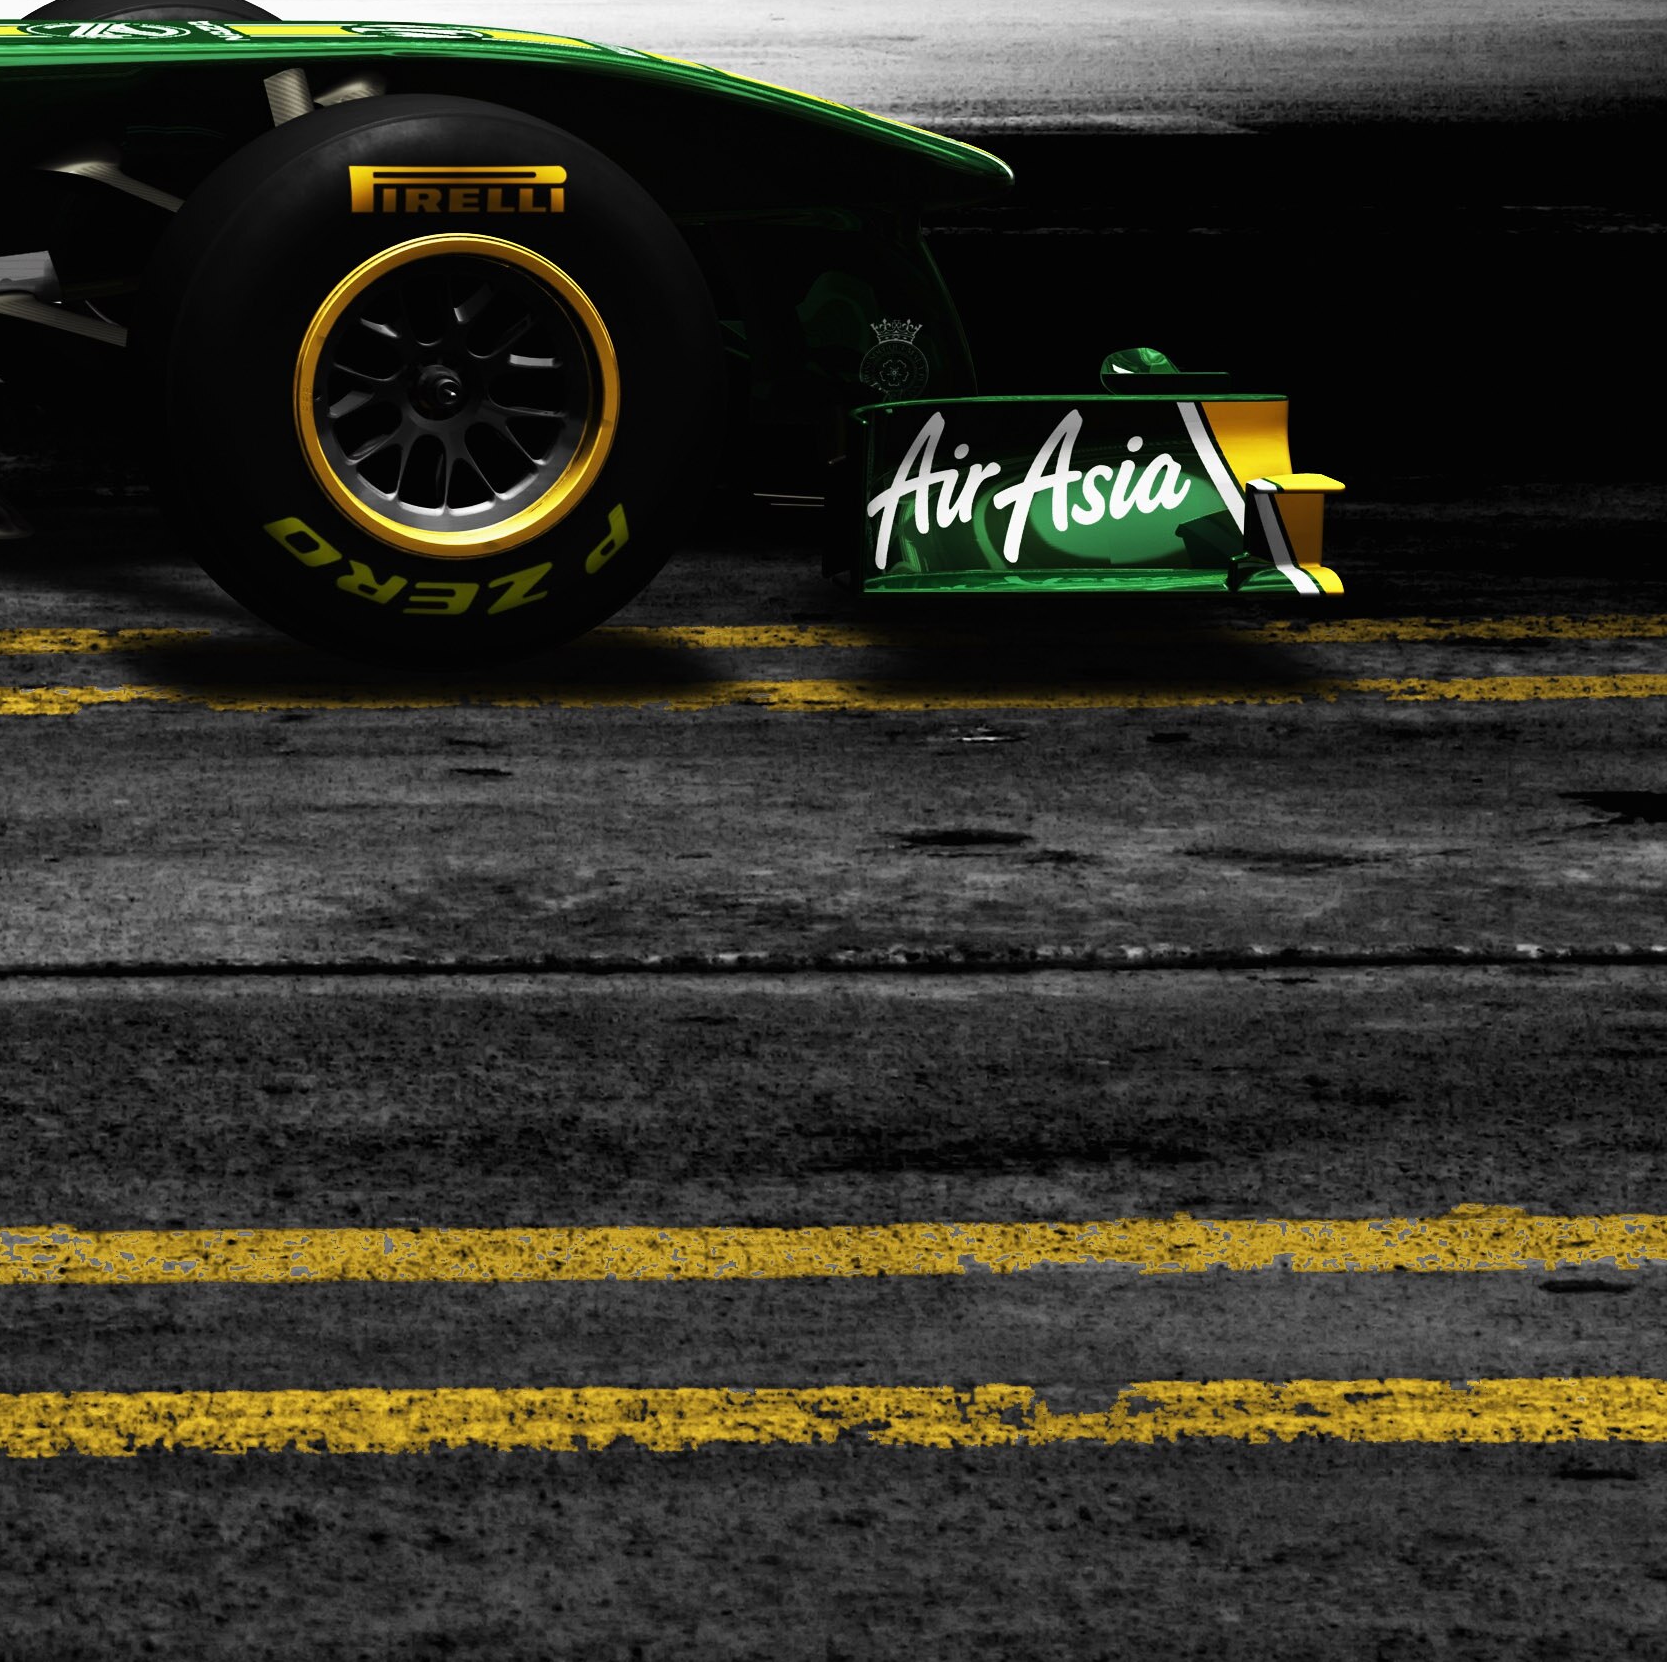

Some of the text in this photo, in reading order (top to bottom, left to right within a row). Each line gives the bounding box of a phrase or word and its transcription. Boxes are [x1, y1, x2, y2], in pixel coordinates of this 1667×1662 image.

[348, 165, 568, 214] PIRELLI
[262, 502, 630, 617] P ZERO
